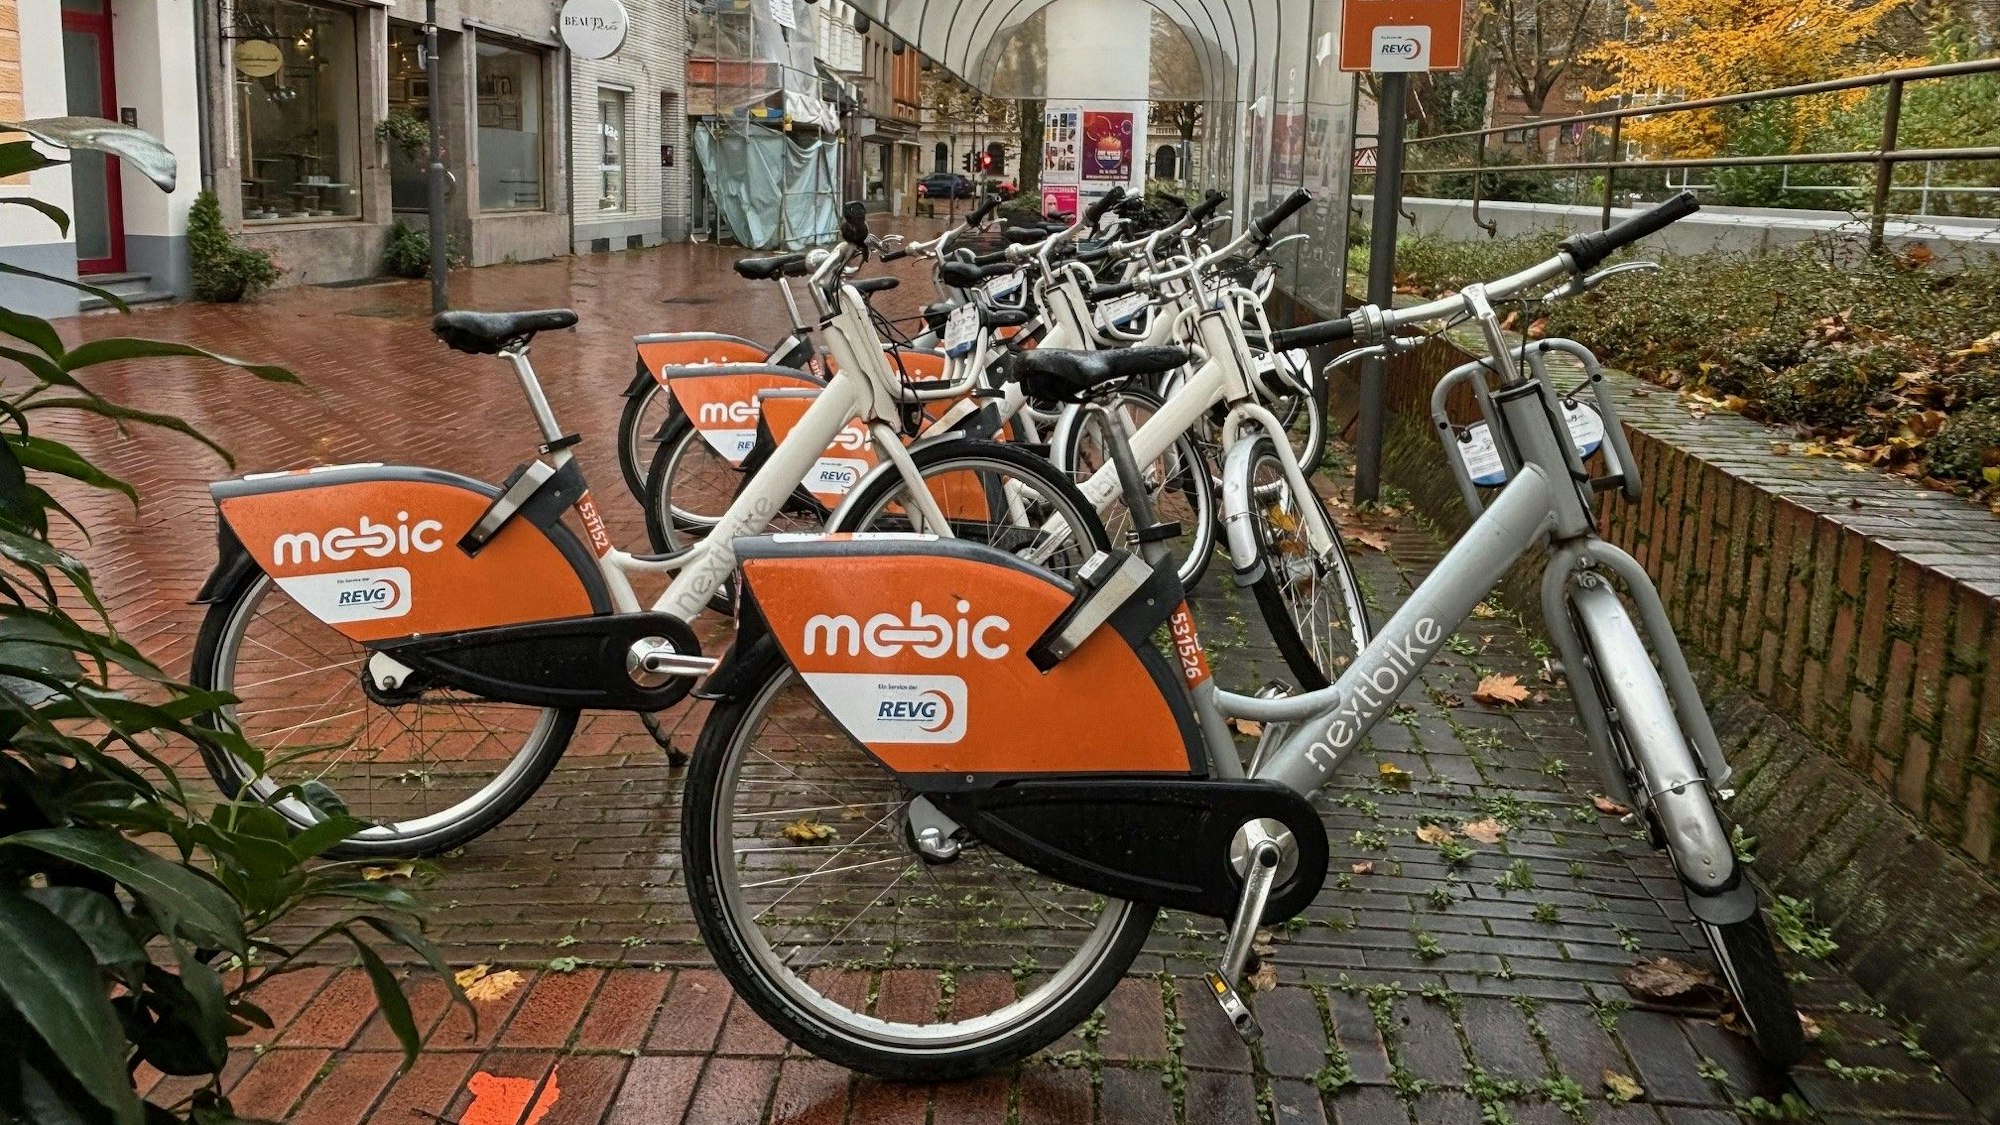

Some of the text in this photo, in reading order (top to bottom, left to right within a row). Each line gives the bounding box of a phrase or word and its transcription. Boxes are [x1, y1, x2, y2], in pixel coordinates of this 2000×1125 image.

[565, 16, 604, 31] BEAUTY
[1381, 44, 1413, 53] REVG
[820, 471, 852, 481] REVG
[273, 510, 443, 566] mobic
[579, 501, 609, 550] 531152
[339, 588, 386, 604] REVG
[803, 599, 1011, 660] mobic
[1170, 611, 1202, 680] 531526
[878, 701, 937, 718] REVG
[1304, 616, 1442, 773] nextbike
